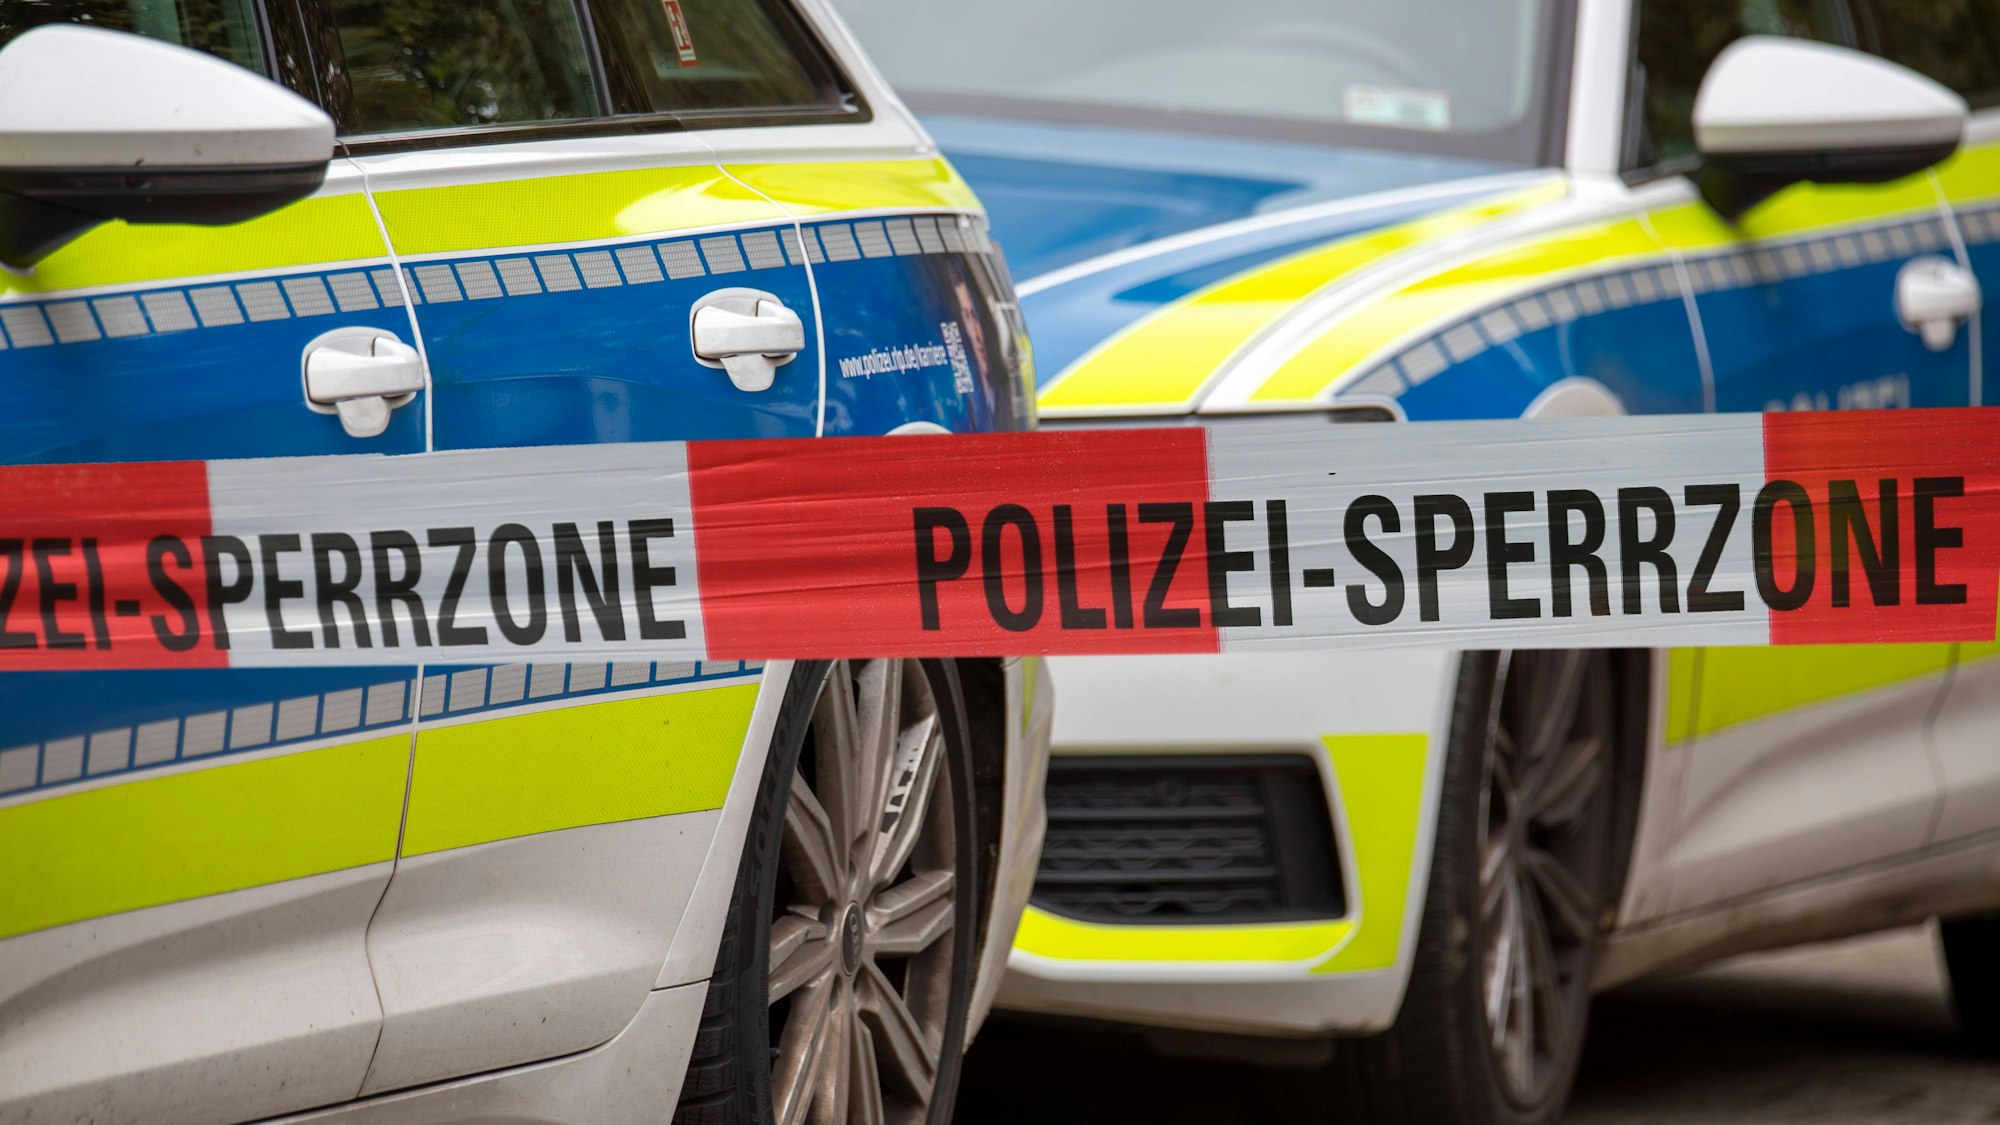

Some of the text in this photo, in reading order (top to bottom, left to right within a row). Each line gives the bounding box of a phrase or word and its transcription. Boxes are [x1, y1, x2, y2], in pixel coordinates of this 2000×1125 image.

[838, 341, 948, 380] www.polizei.rlp.de/karriere
[0, 519, 687, 652] ZEI-SPERRZONE
[912, 476, 1968, 633] POLIZEI-SPERRZONE
